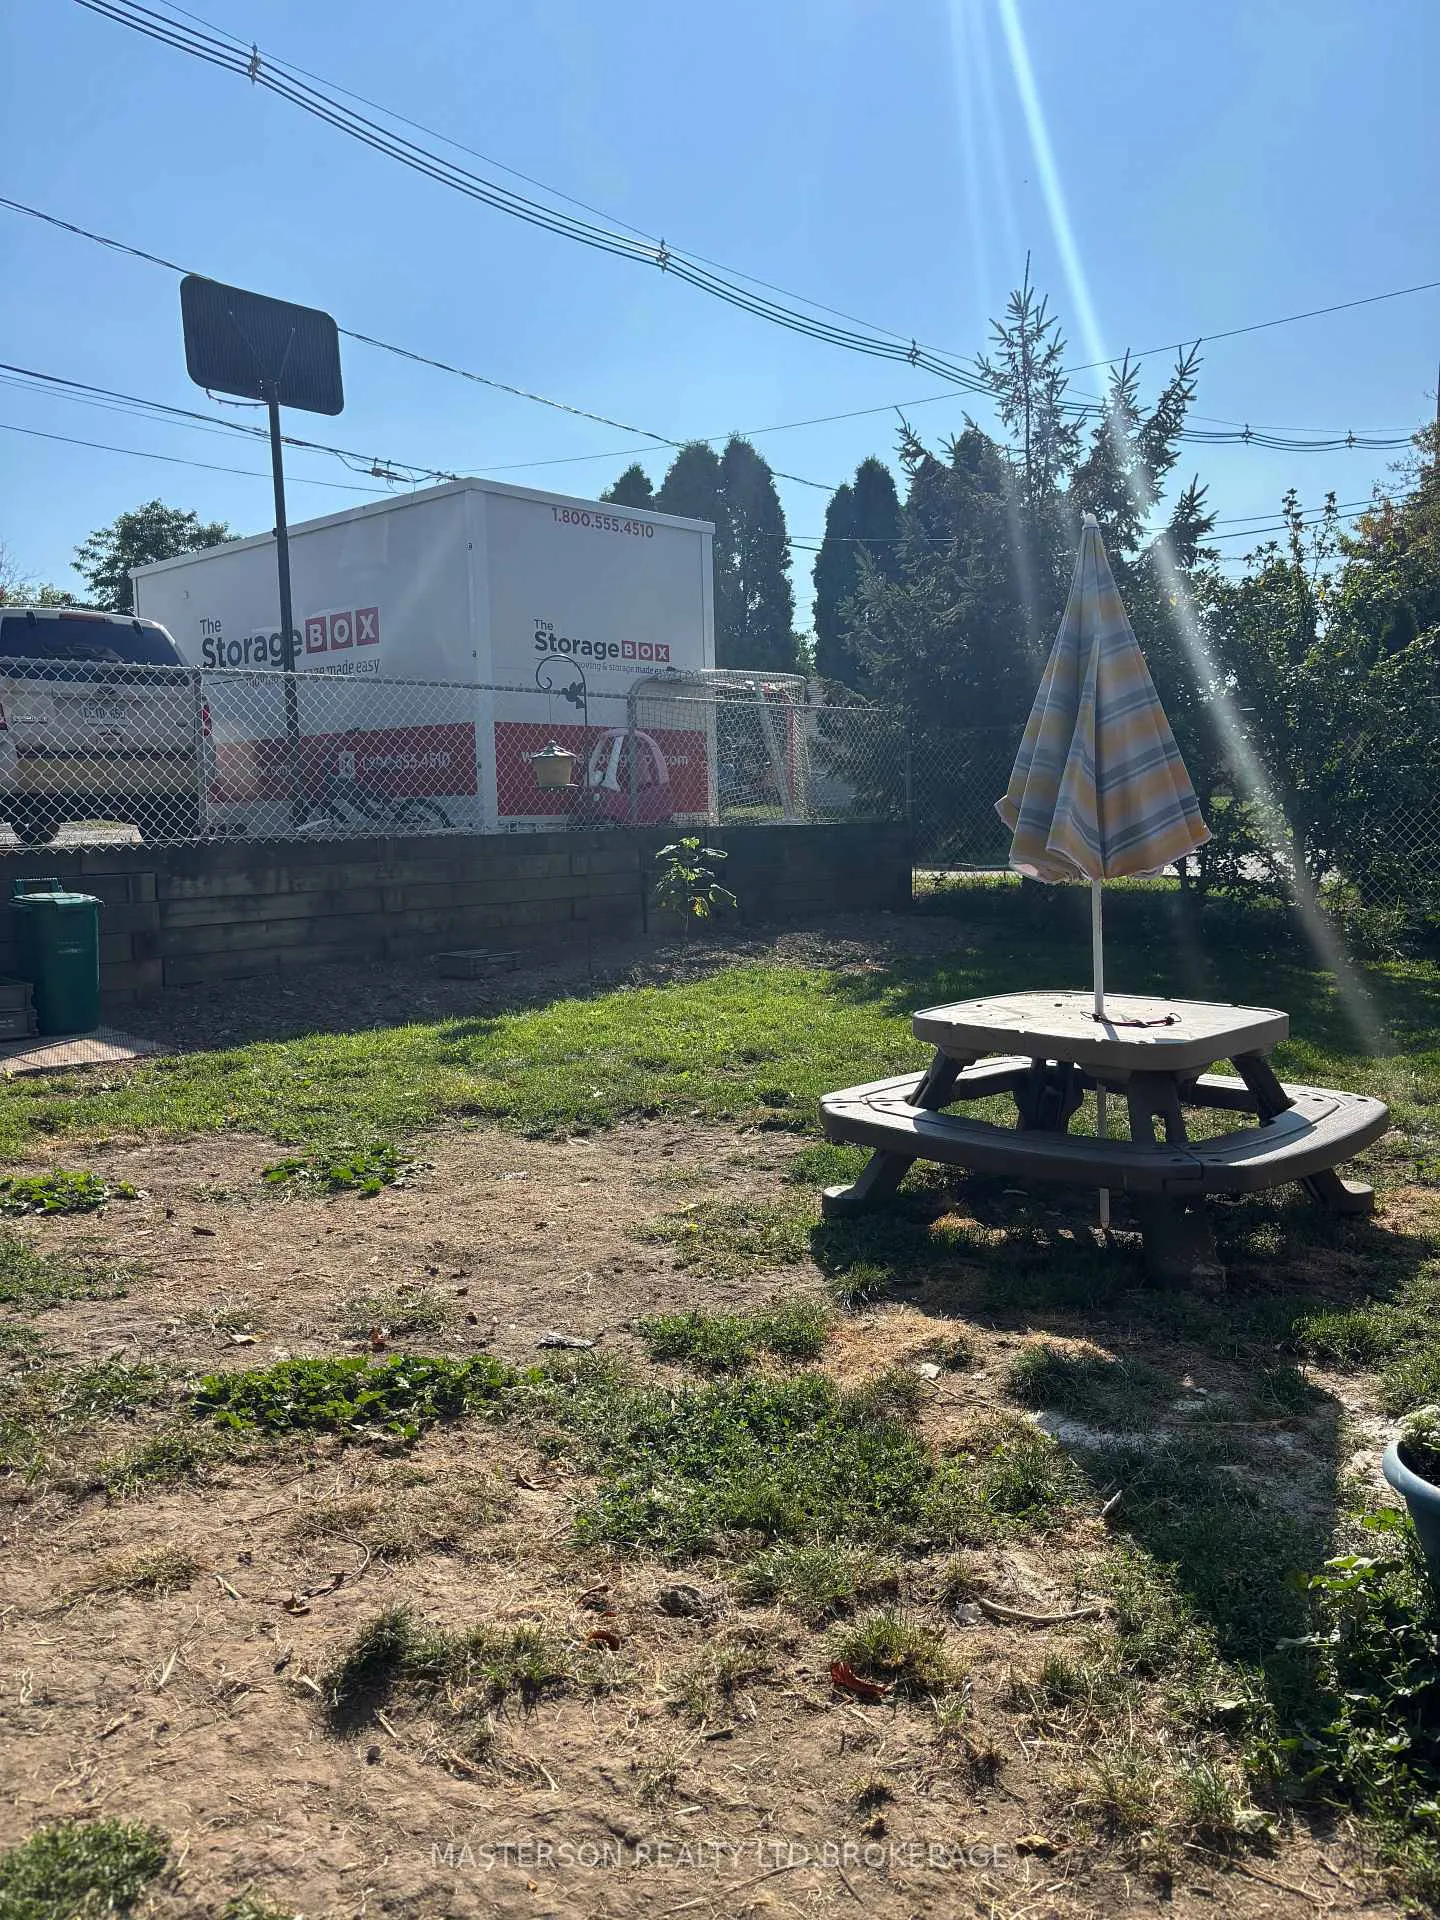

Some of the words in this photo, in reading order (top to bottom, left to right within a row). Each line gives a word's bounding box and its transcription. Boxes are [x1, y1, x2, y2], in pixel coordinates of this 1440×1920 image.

[551, 507, 655, 539] 1.800.555.4510
[200, 617, 222, 635] The
[534, 619, 553, 631] The
[356, 659, 381, 675] easy
